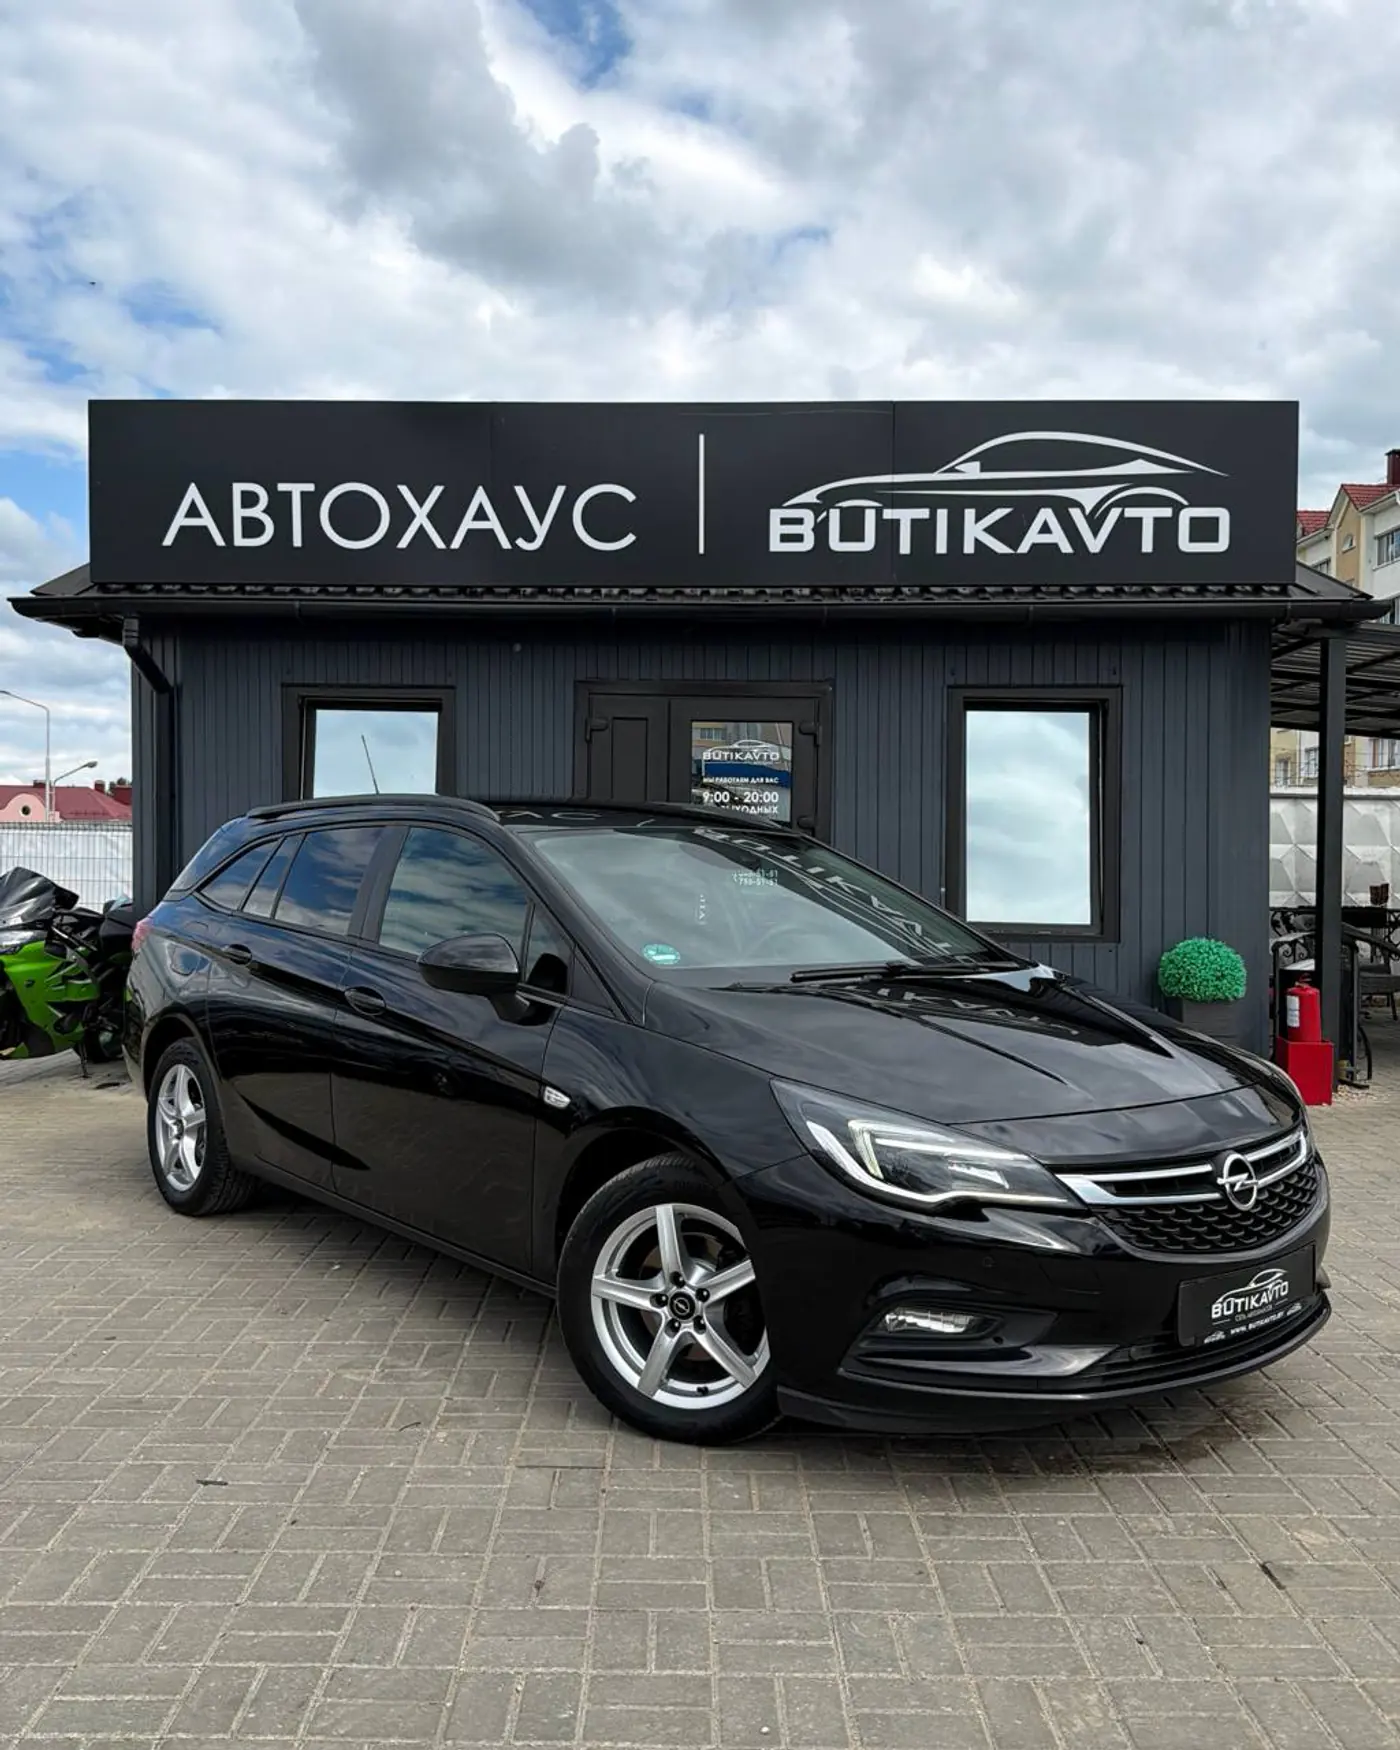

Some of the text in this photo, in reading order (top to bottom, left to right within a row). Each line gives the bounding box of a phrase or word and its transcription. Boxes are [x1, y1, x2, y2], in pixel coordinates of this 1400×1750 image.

[163, 483, 636, 550] АВТОХАУС
[769, 508, 1230, 554] BUTIKAVTO
[702, 751, 780, 761] BUTIKAVTO
[702, 791, 730, 803] 9:00
[743, 791, 780, 803] 20:00
[1211, 1280, 1289, 1320] BUTIKAVTO
